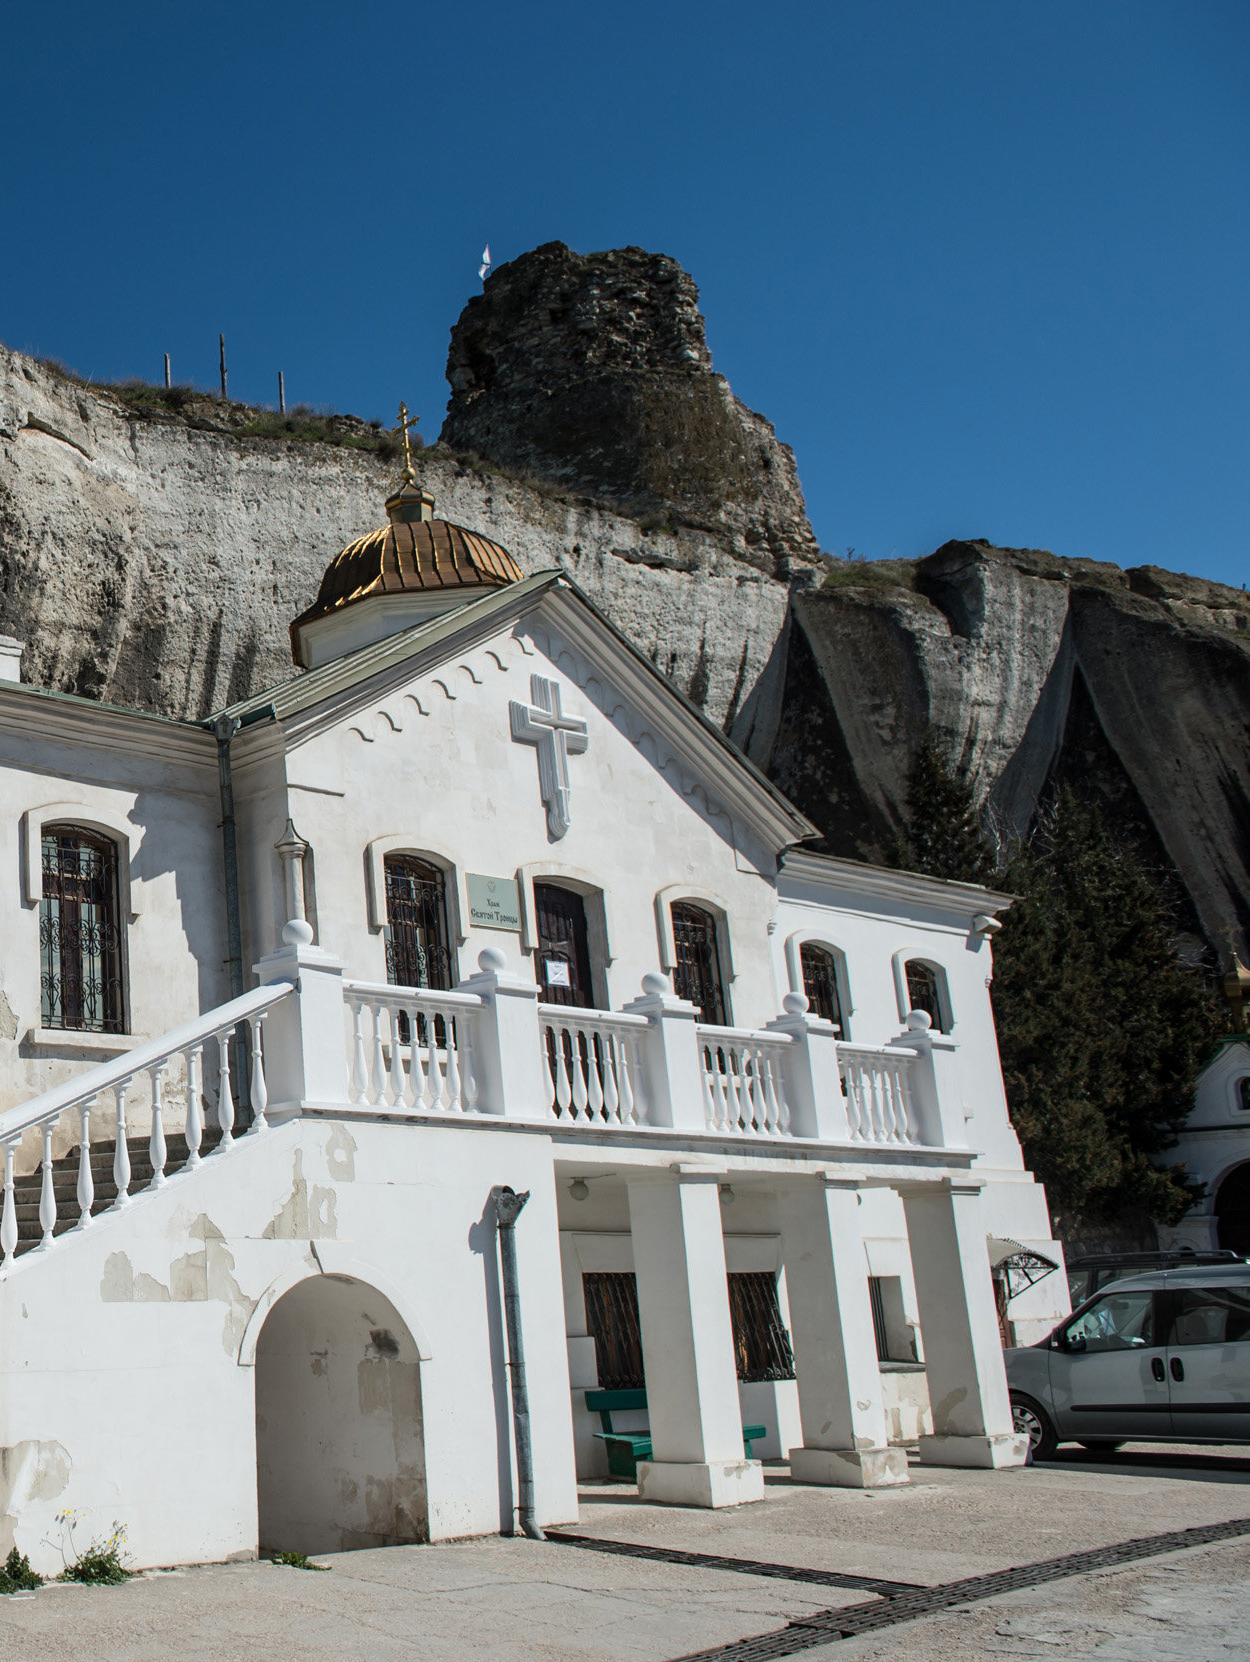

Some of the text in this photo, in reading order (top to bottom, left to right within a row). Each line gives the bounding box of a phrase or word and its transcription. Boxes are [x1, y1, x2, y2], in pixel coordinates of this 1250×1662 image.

[486, 898, 500, 909] Храм
[470, 908, 518, 925] Святой Троицы
